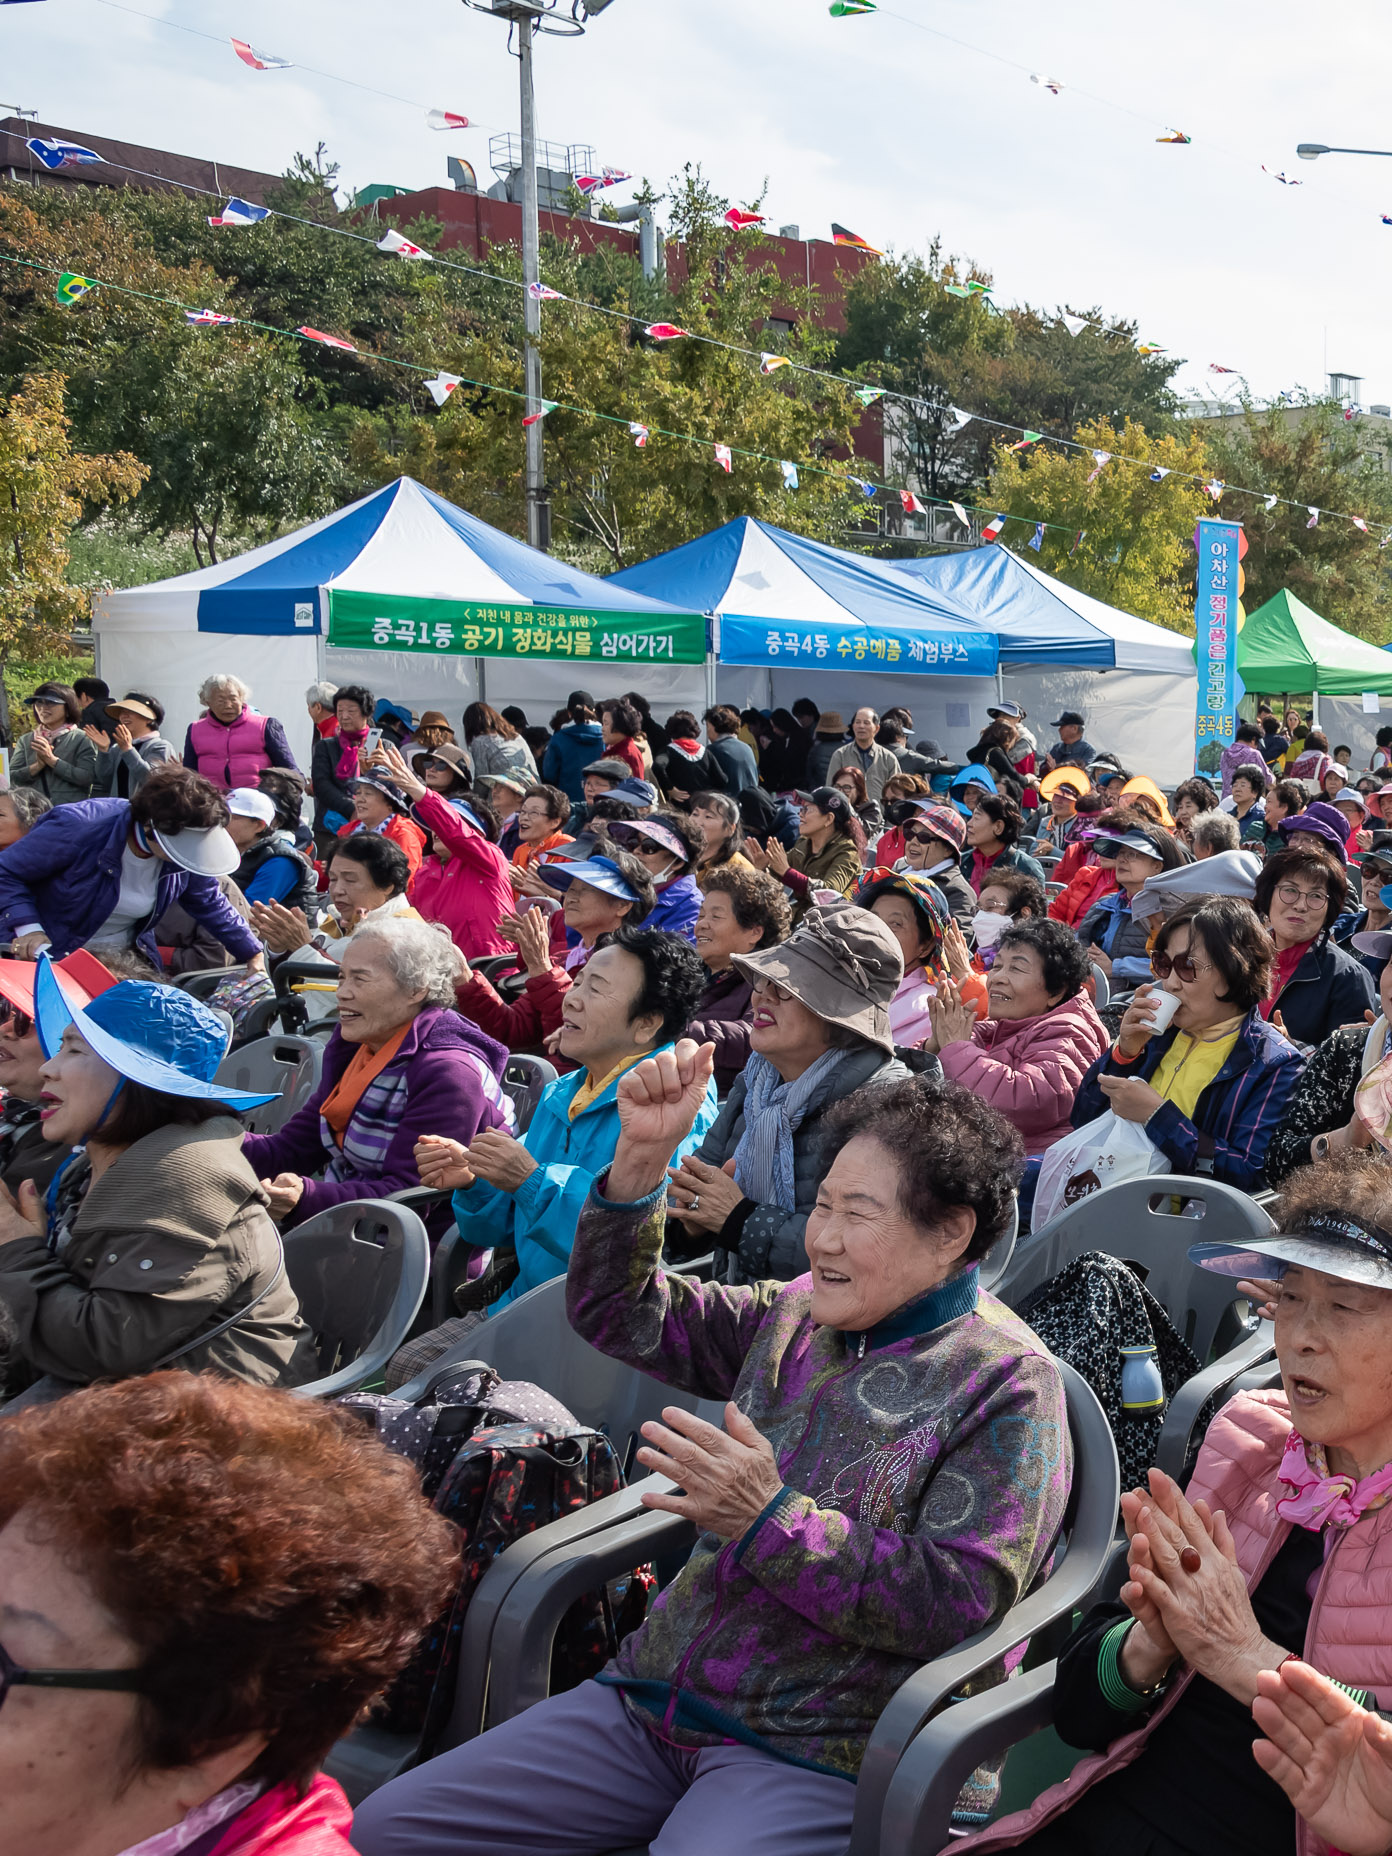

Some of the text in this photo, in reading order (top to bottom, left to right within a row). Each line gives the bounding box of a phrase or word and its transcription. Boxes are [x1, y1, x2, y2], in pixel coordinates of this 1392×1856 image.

[1210, 542, 1229, 590] 아차산
[476, 608, 498, 623] 지친
[500, 609, 511, 624] 내
[514, 611, 534, 625] 몸과
[537, 613, 567, 627] 건강을
[371, 616, 674, 658] 중곡1동 공기 정화식물 심어가기
[765, 630, 969, 665] 중곡4동 수공예품 체험부스
[1197, 714, 1234, 737] 중곡4동
